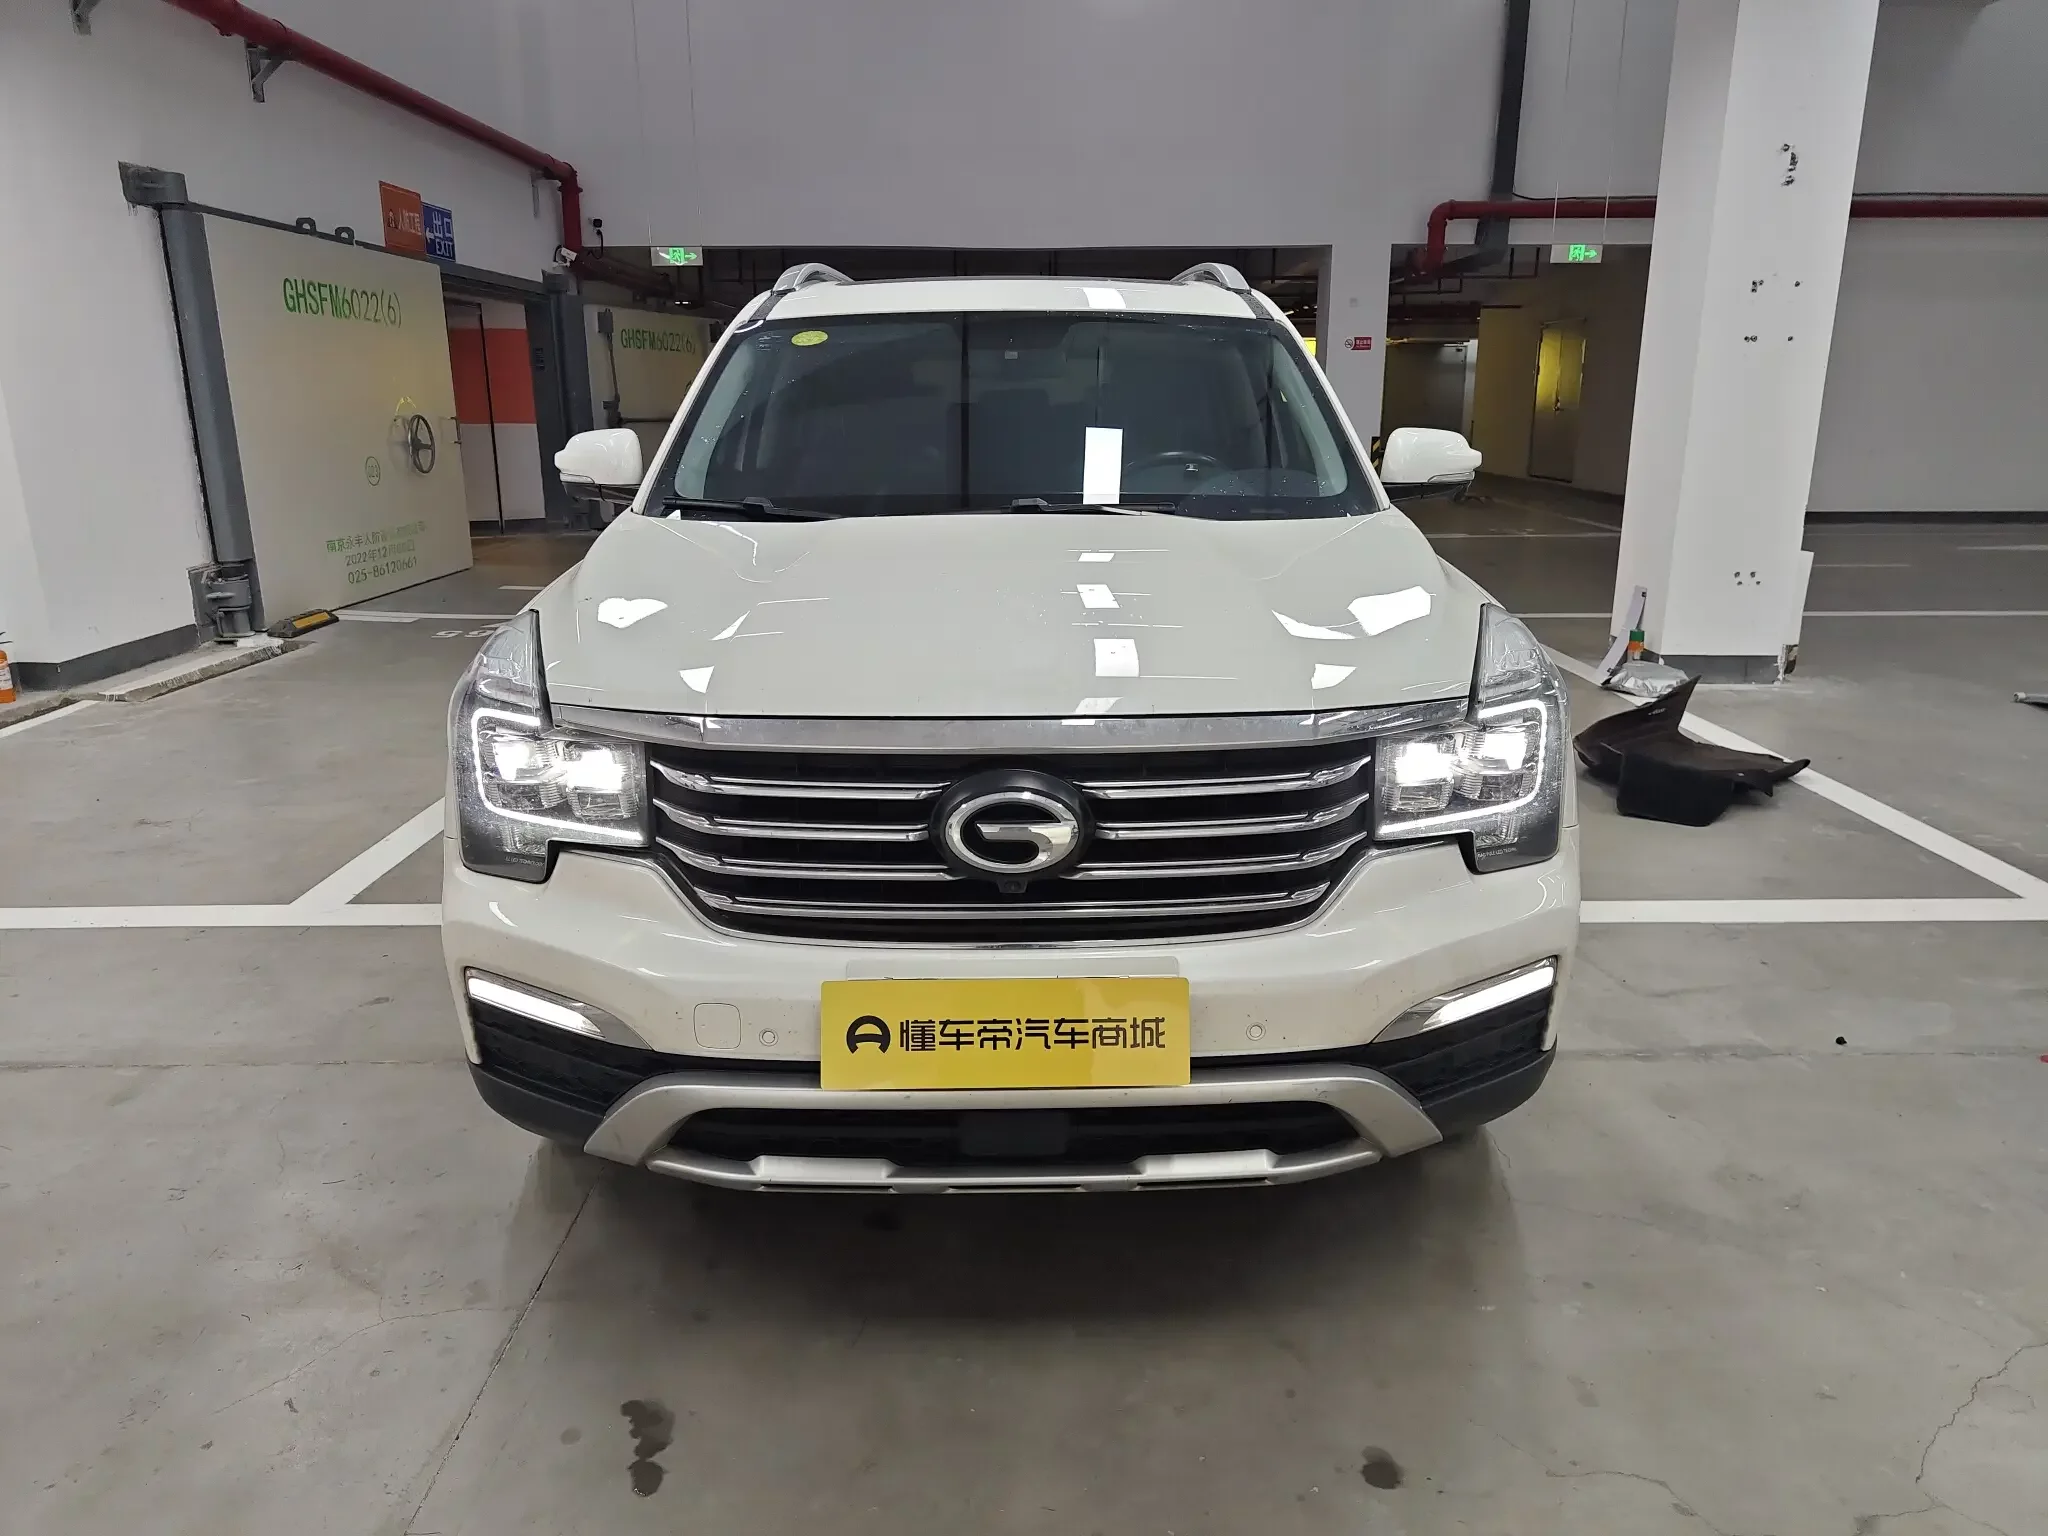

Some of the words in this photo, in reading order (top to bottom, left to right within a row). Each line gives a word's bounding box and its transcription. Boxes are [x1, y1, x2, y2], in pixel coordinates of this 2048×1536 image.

[432, 211, 454, 239] 出口
[436, 239, 453, 258] EXIT
[283, 277, 402, 329] GHSFM6022(6)
[899, 1016, 1166, 1051] 懂车帝汽车商城
